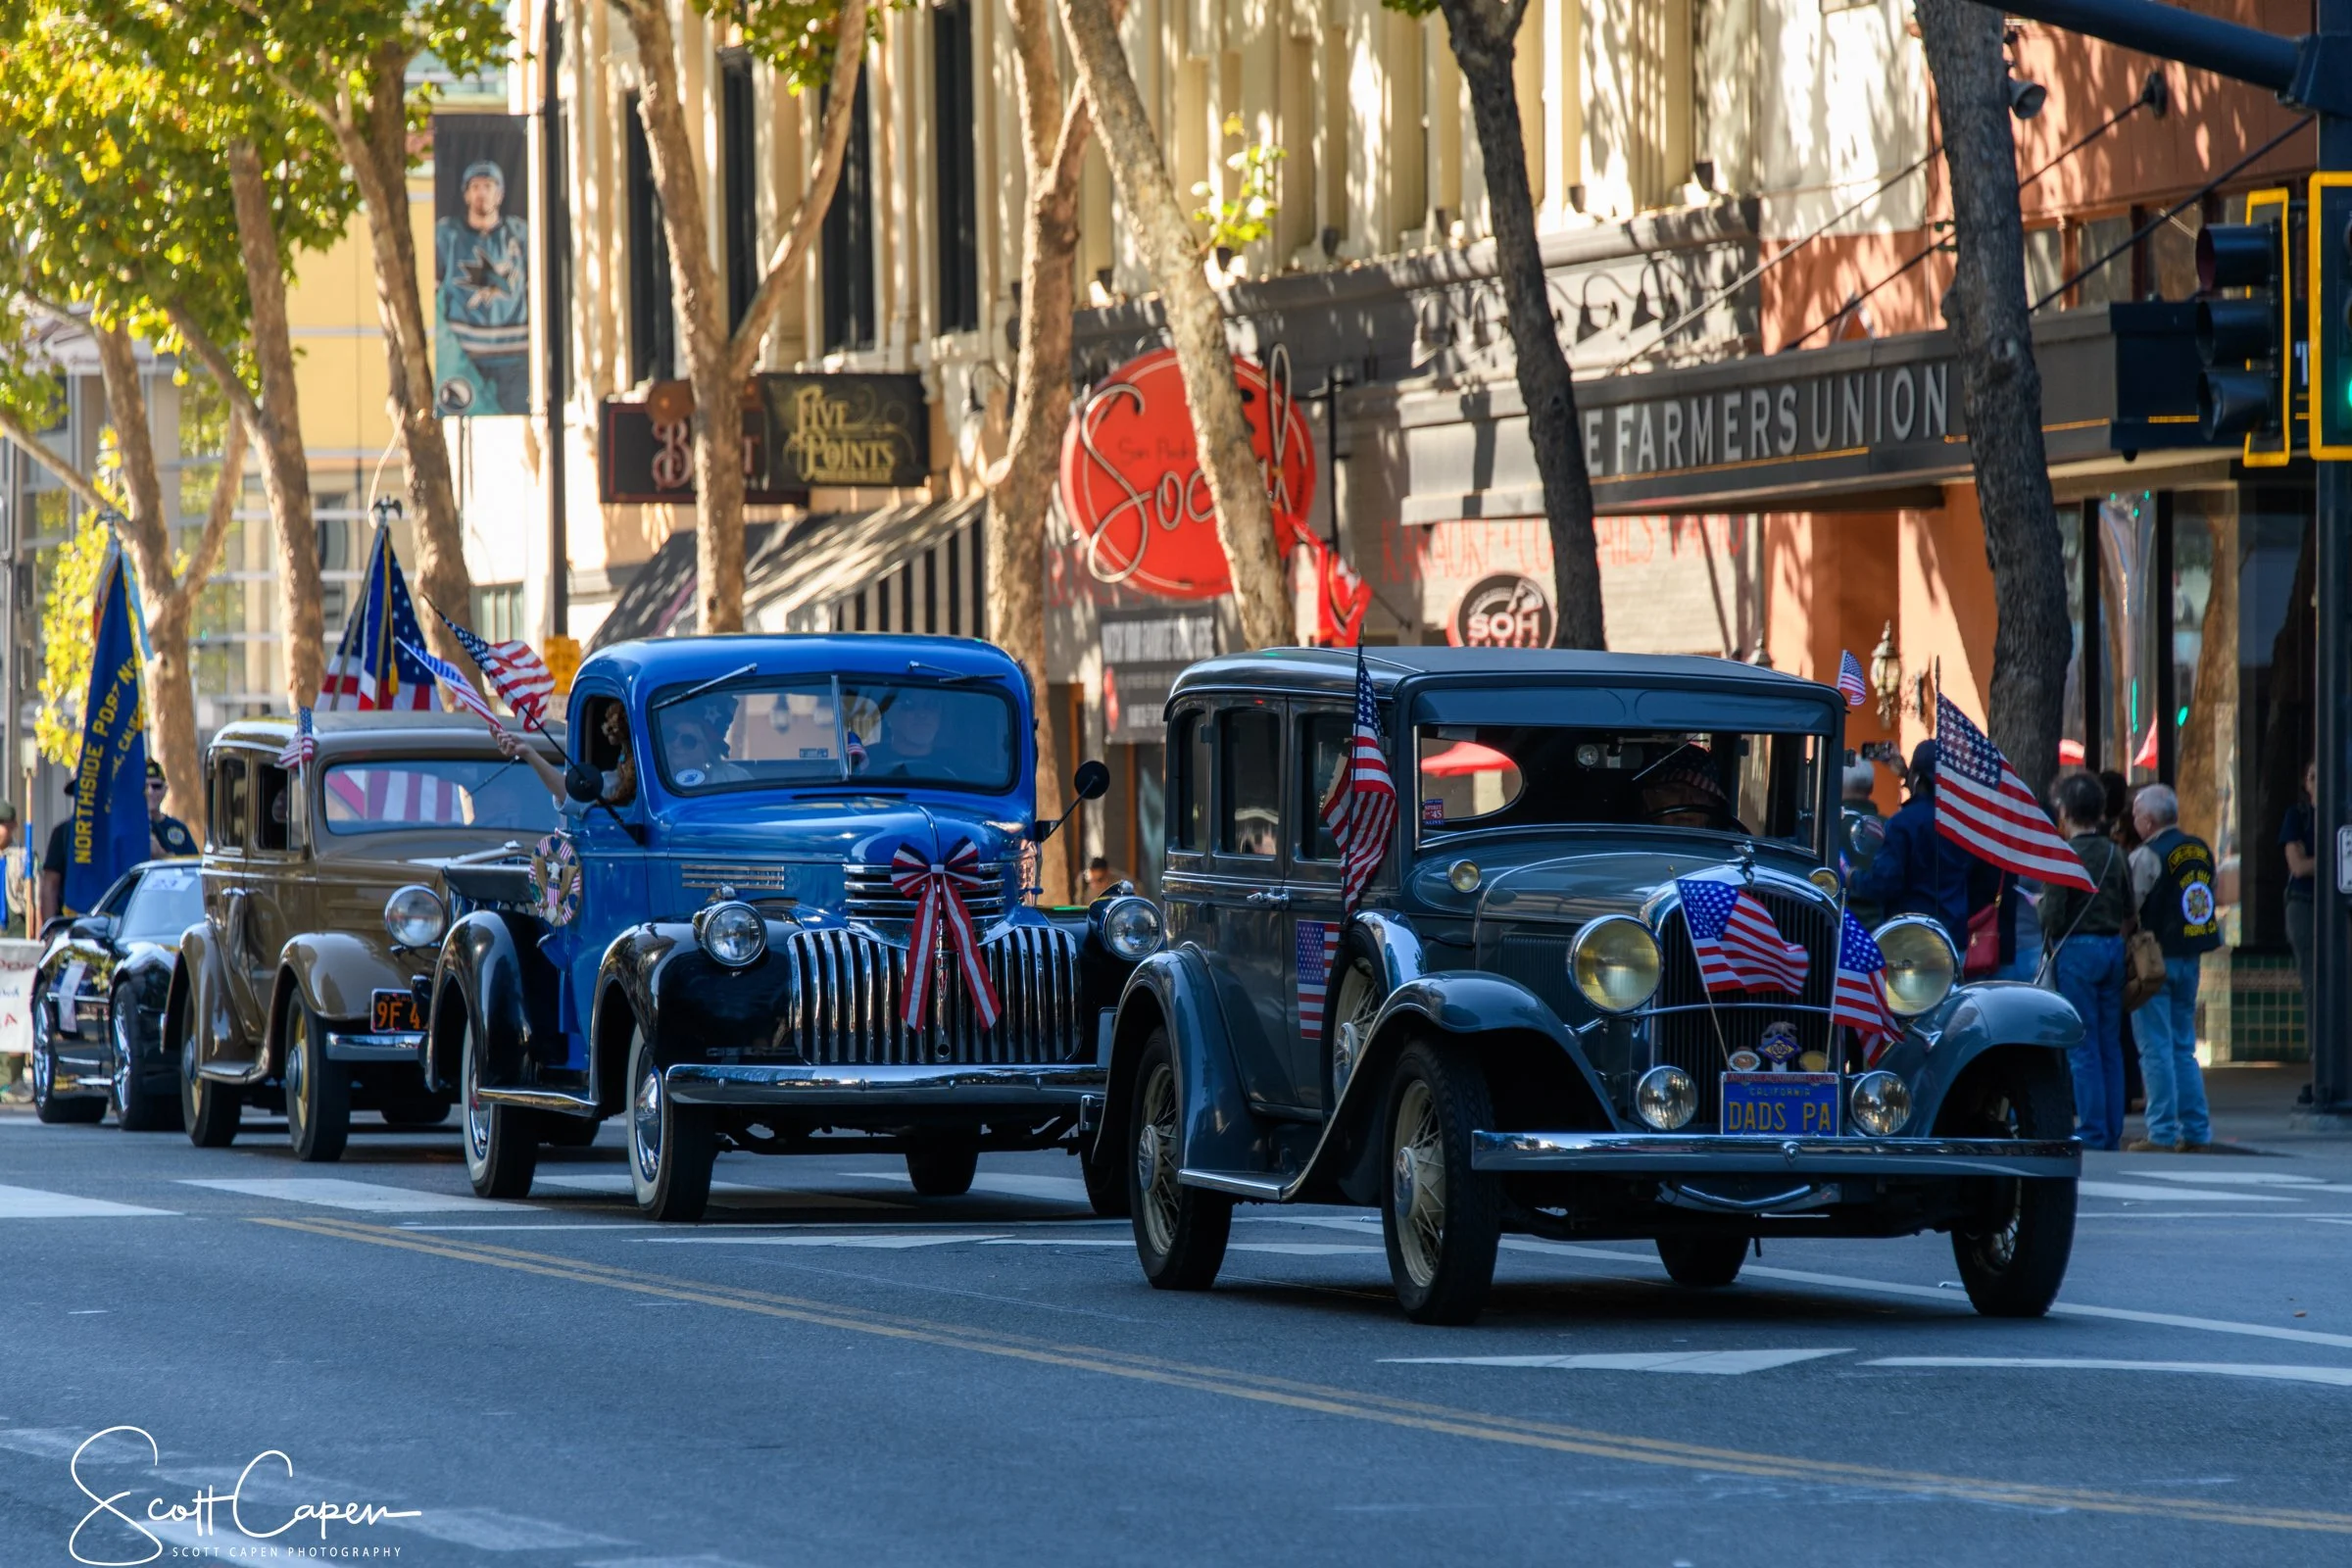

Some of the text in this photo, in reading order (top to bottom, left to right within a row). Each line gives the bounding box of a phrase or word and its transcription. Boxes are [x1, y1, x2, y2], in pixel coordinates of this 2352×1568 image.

[794, 384, 850, 432] FIVE
[1614, 384, 1798, 474] FARMERS
[1811, 362, 1949, 452] UNION
[788, 434, 895, 482] POINTS
[1467, 612, 1541, 641] SOH
[74, 742, 105, 864] NORTHSIDE
[377, 1002, 403, 1029] 9F
[1749, 1088, 1811, 1097] CALIFORNIA
[1728, 1102, 1832, 1131] DADS PA
